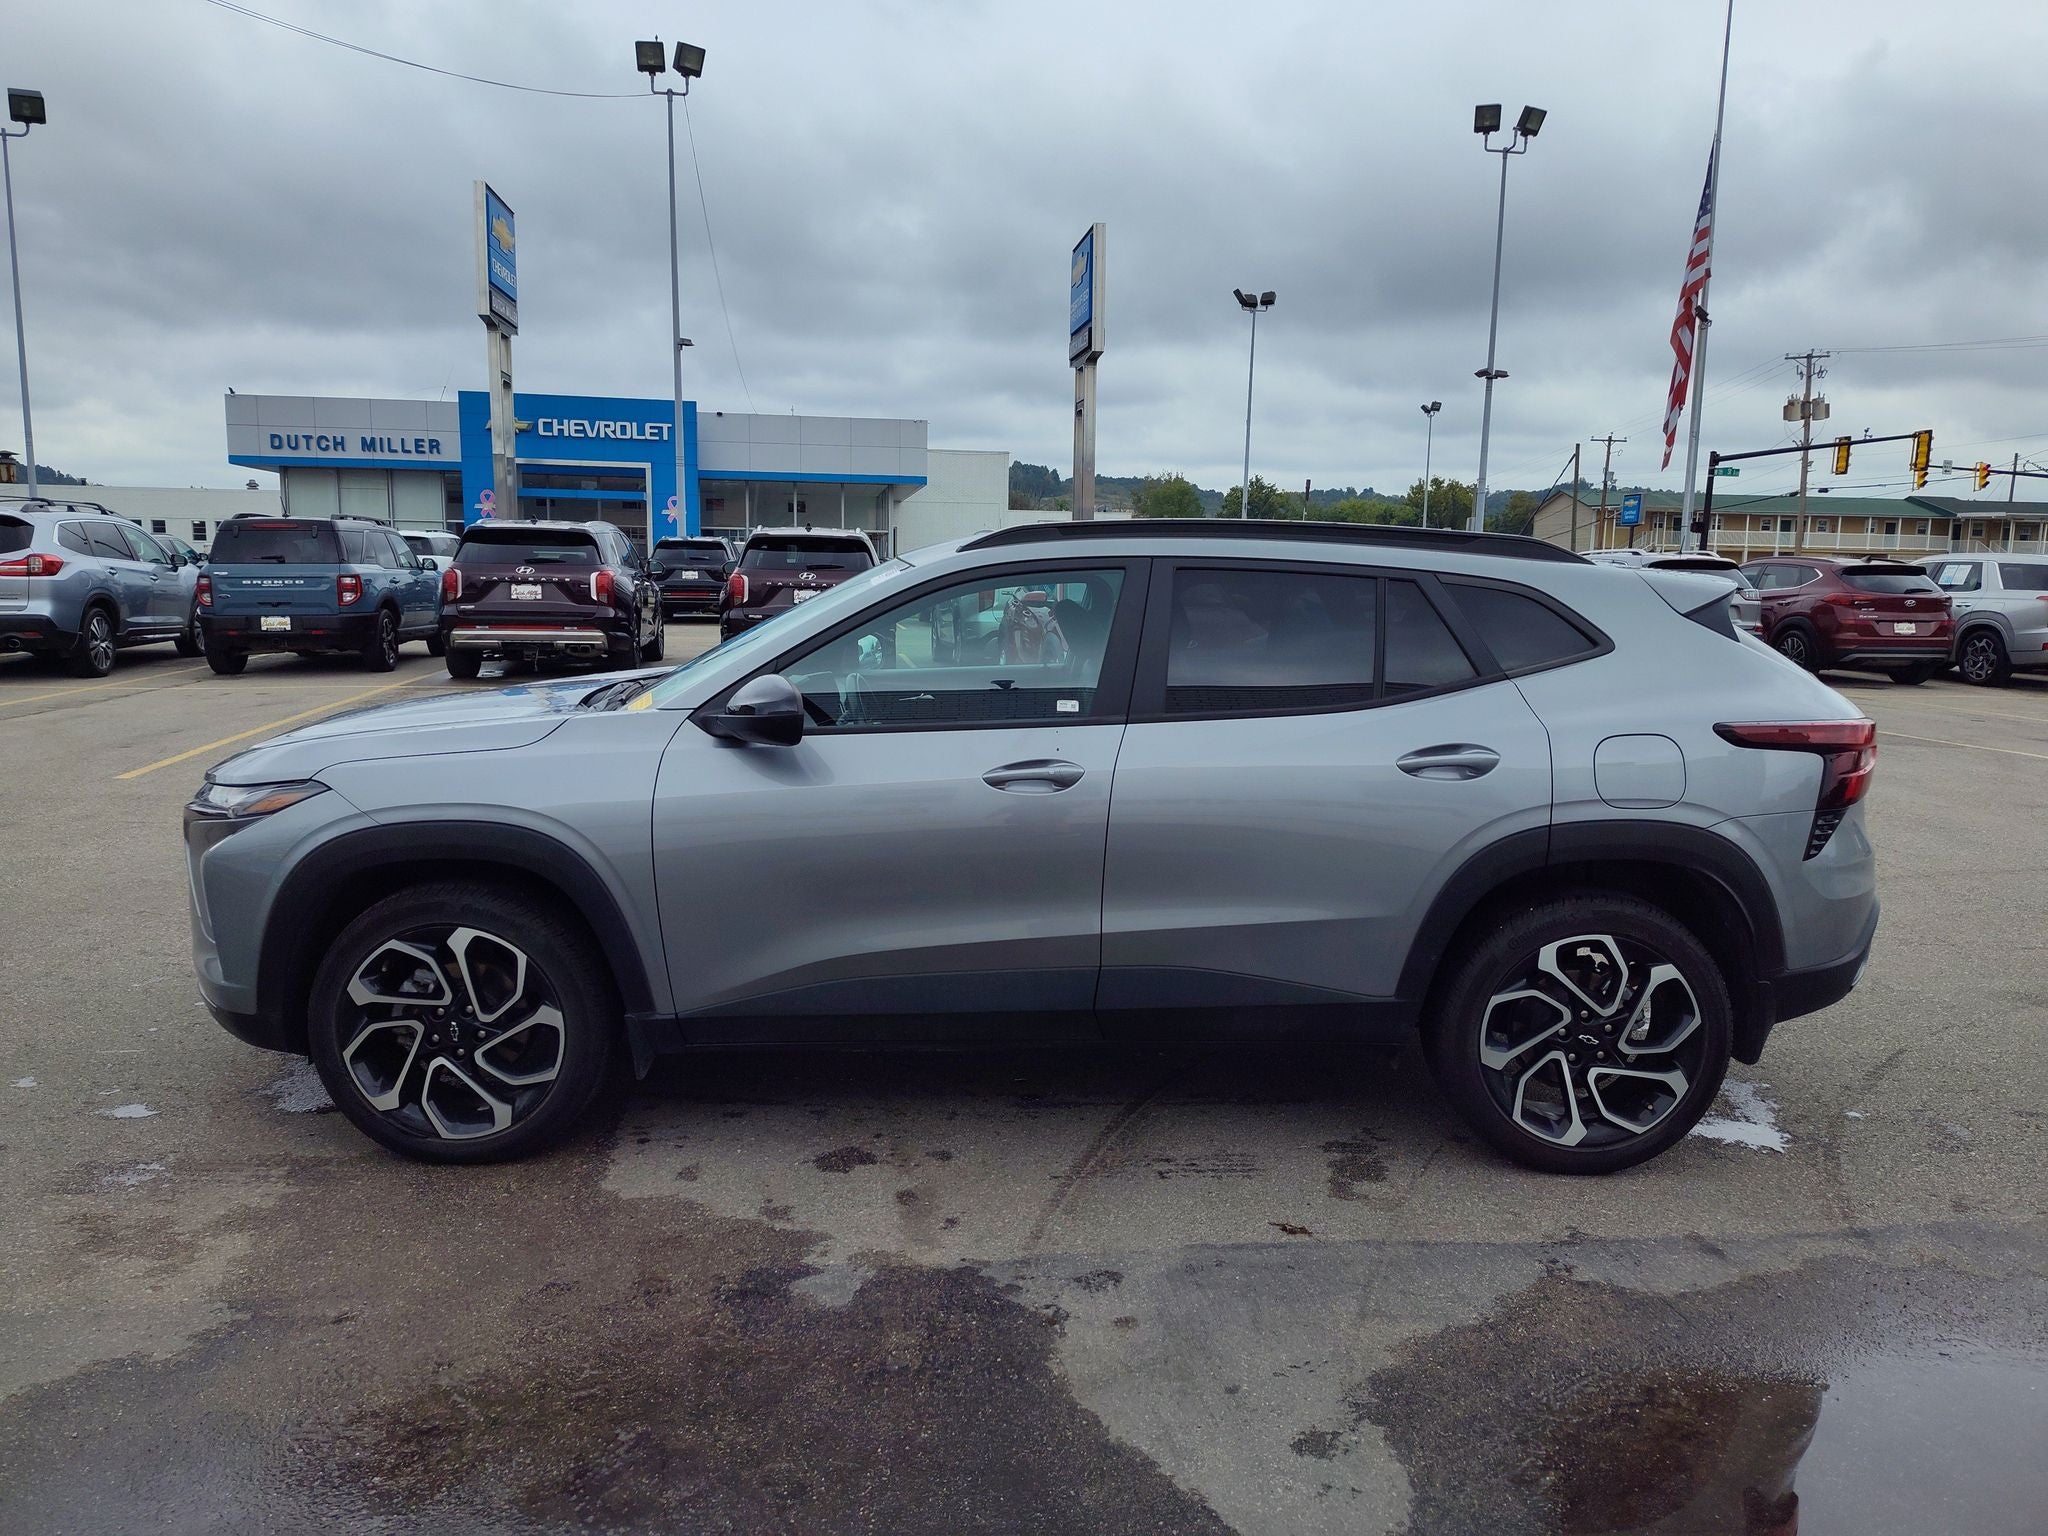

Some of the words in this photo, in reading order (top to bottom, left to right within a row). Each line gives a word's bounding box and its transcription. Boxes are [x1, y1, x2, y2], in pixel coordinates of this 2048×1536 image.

[537, 418, 672, 441] CHEVROLET
[269, 433, 346, 452] DUTCH
[361, 436, 441, 454] MILLER
